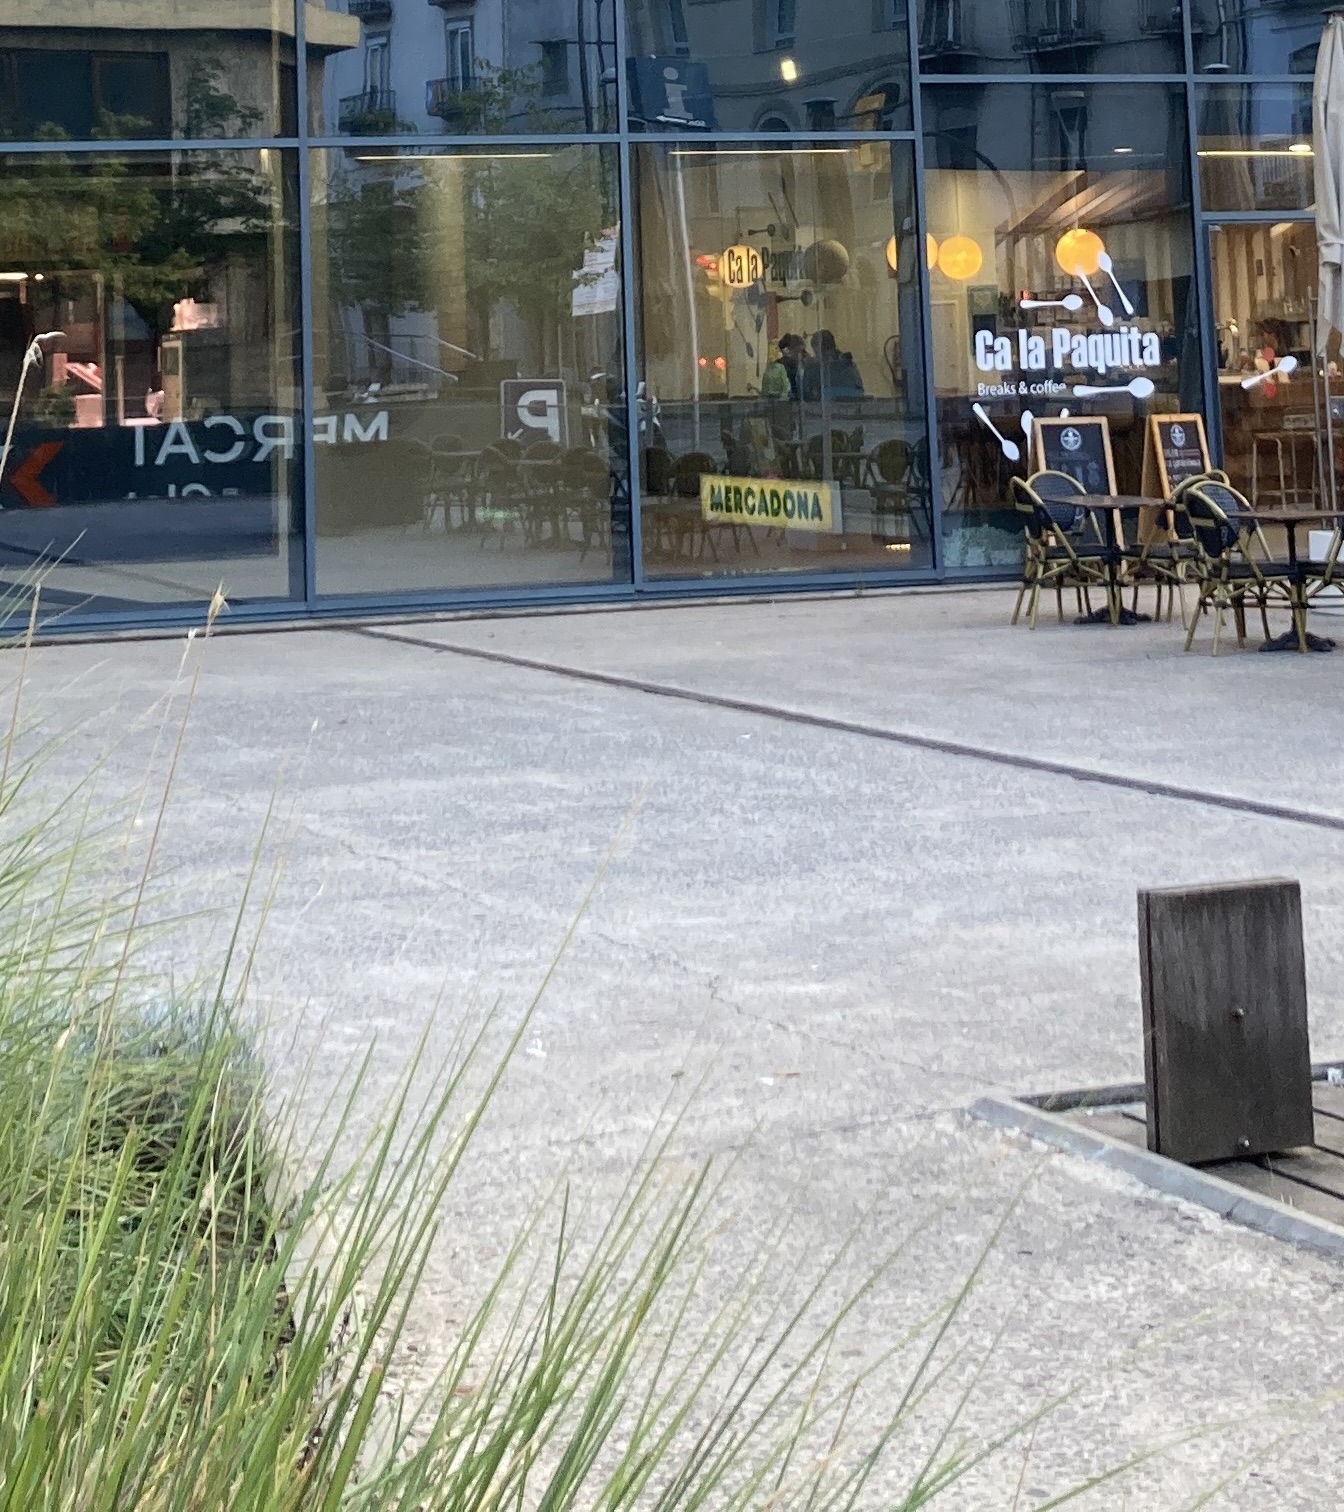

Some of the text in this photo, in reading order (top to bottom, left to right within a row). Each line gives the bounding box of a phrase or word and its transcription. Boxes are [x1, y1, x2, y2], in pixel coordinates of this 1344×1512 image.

[726, 248, 744, 285] Ca
[747, 247, 757, 283] la
[975, 325, 1161, 374] Ca la Paquita
[977, 380, 1067, 396] Breaks & coffee
[709, 484, 824, 522] MERCADONA
